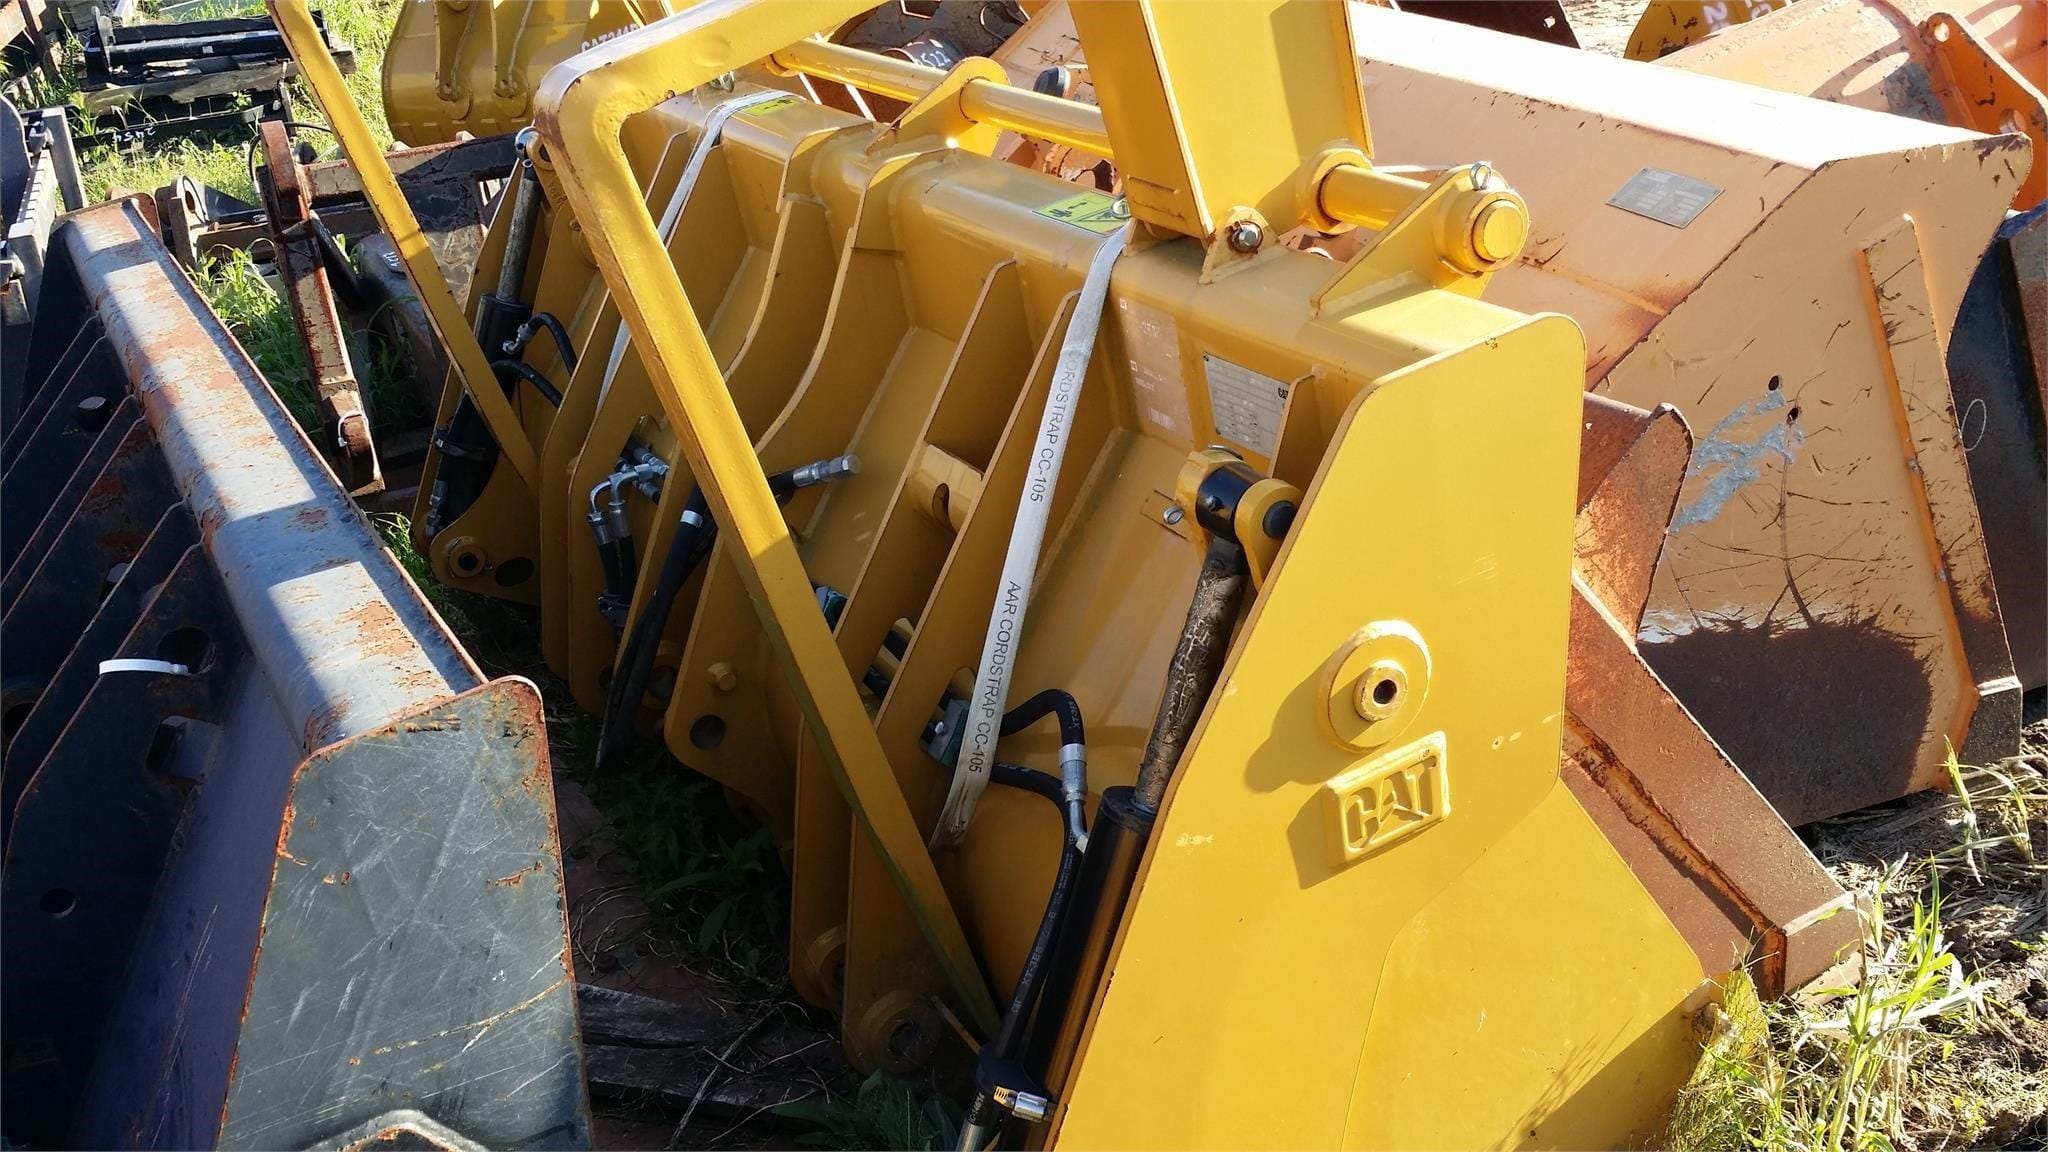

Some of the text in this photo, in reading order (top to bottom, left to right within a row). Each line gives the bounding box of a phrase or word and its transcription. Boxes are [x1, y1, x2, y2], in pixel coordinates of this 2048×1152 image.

[112, 127, 156, 143] 2454
[1030, 448, 1055, 502] CC-105
[969, 580, 1022, 773] AAR CORDSTRAP CC-105
[1342, 754, 1438, 852] CAT
